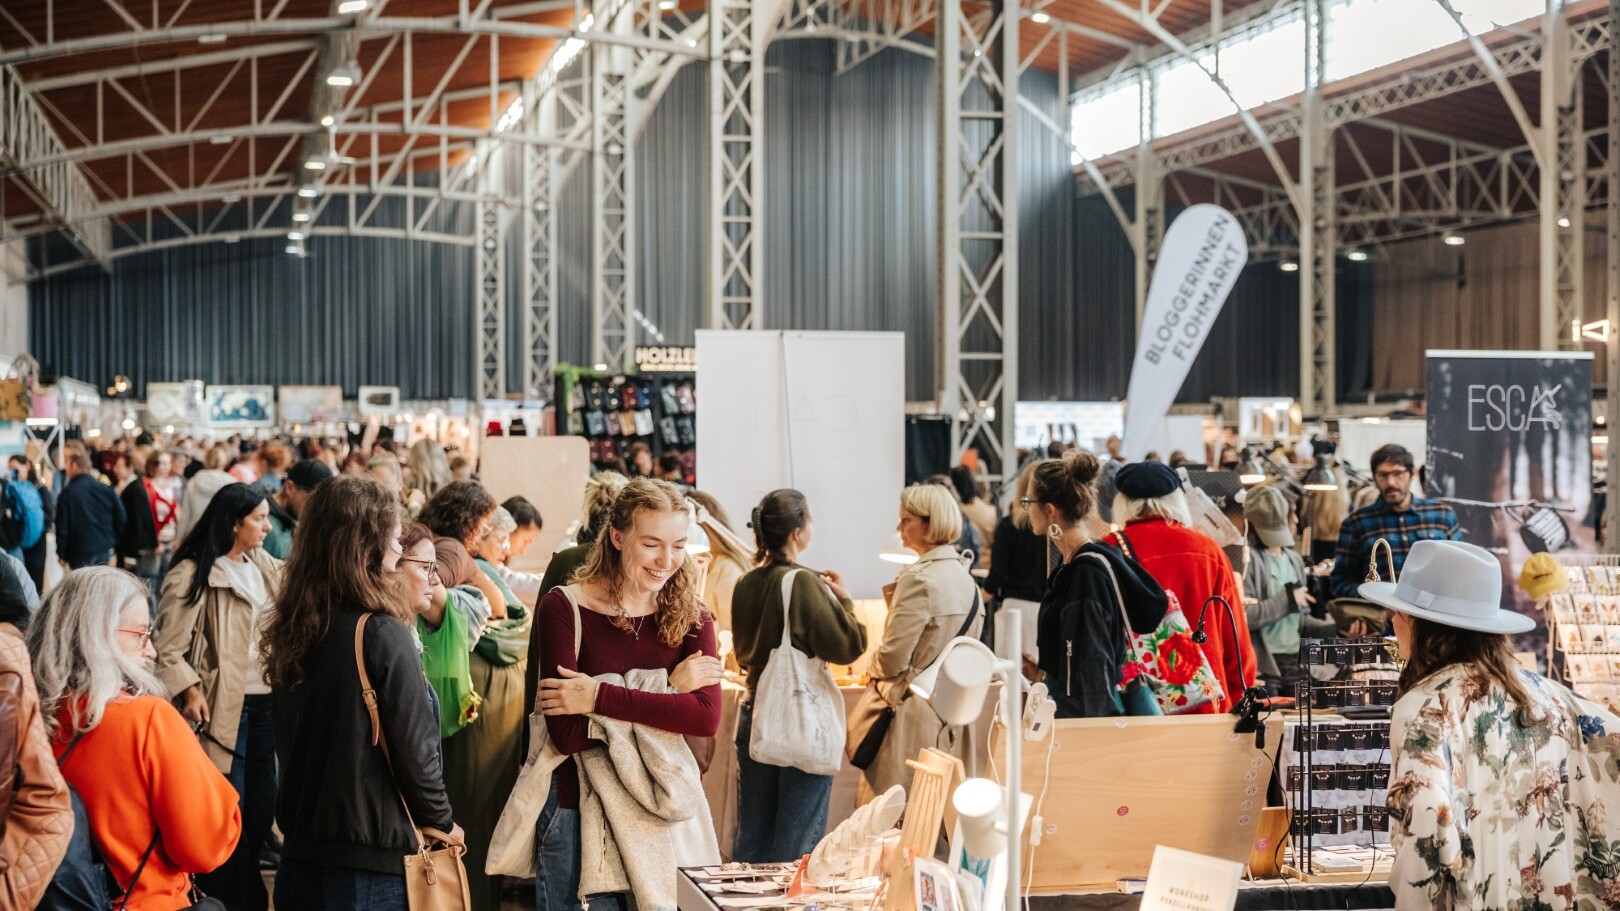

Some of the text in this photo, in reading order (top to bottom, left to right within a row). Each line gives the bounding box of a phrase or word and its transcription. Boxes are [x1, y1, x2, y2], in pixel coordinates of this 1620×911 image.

[1145, 214, 1230, 365] BLOGGERINNEN
[1172, 241, 1241, 362] FLOHMARKT
[1168, 886, 1209, 902] WORKSHOP
